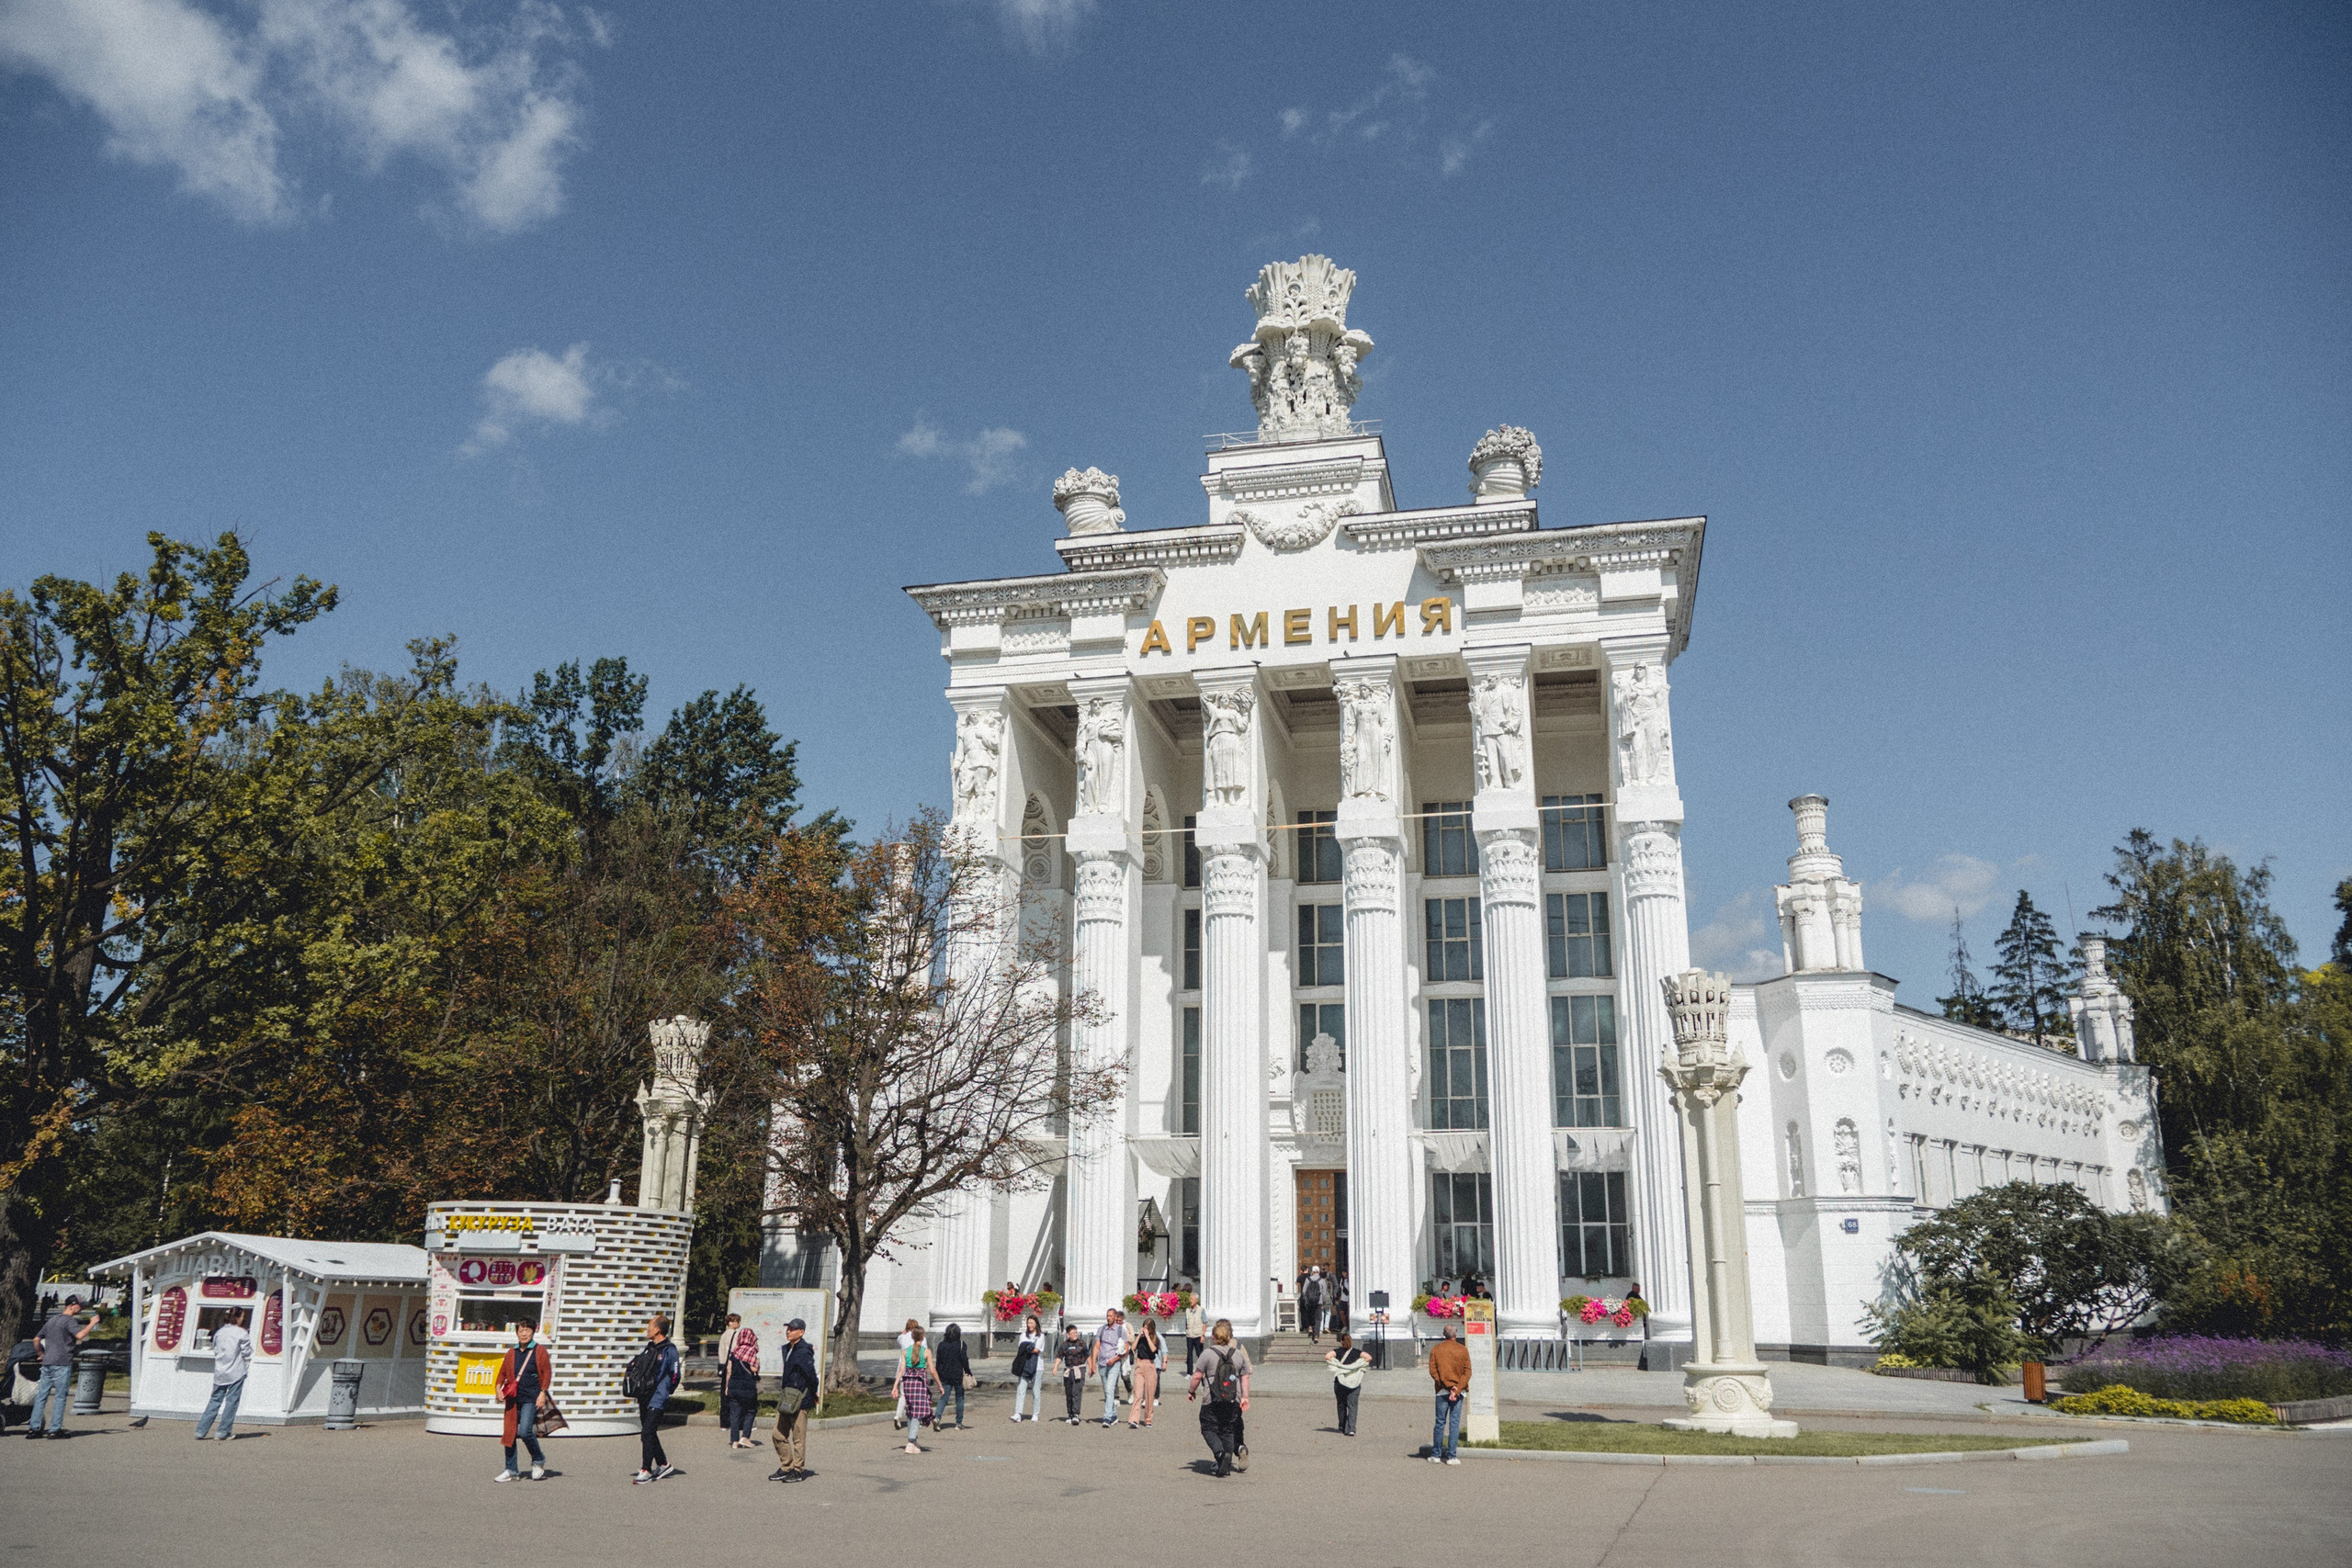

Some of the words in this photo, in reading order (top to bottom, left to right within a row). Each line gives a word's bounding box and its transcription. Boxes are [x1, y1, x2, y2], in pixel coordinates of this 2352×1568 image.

[1139, 596, 1452, 654] АРМЕНИЯ
[448, 1215, 533, 1231] КУКУРУЗА
[546, 1216, 596, 1233] ВАТА
